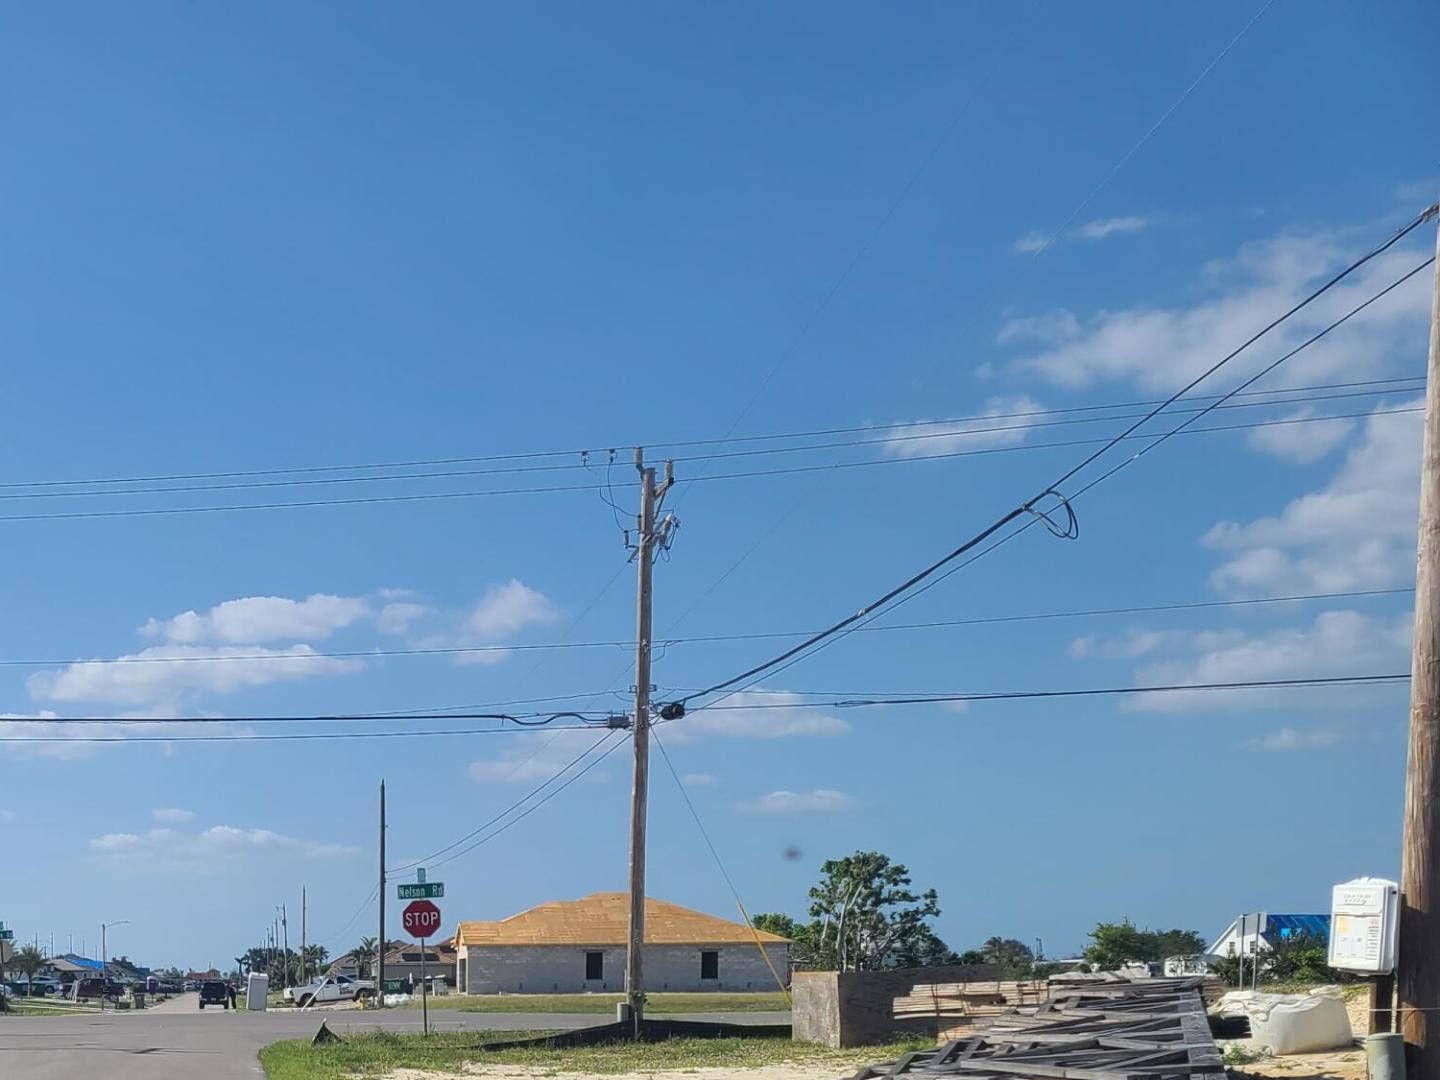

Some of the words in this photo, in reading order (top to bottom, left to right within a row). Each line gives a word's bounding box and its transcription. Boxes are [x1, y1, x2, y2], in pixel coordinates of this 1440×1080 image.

[399, 886, 426, 898] Nelson
[432, 885, 443, 896] Rd
[405, 911, 439, 927] STOP
